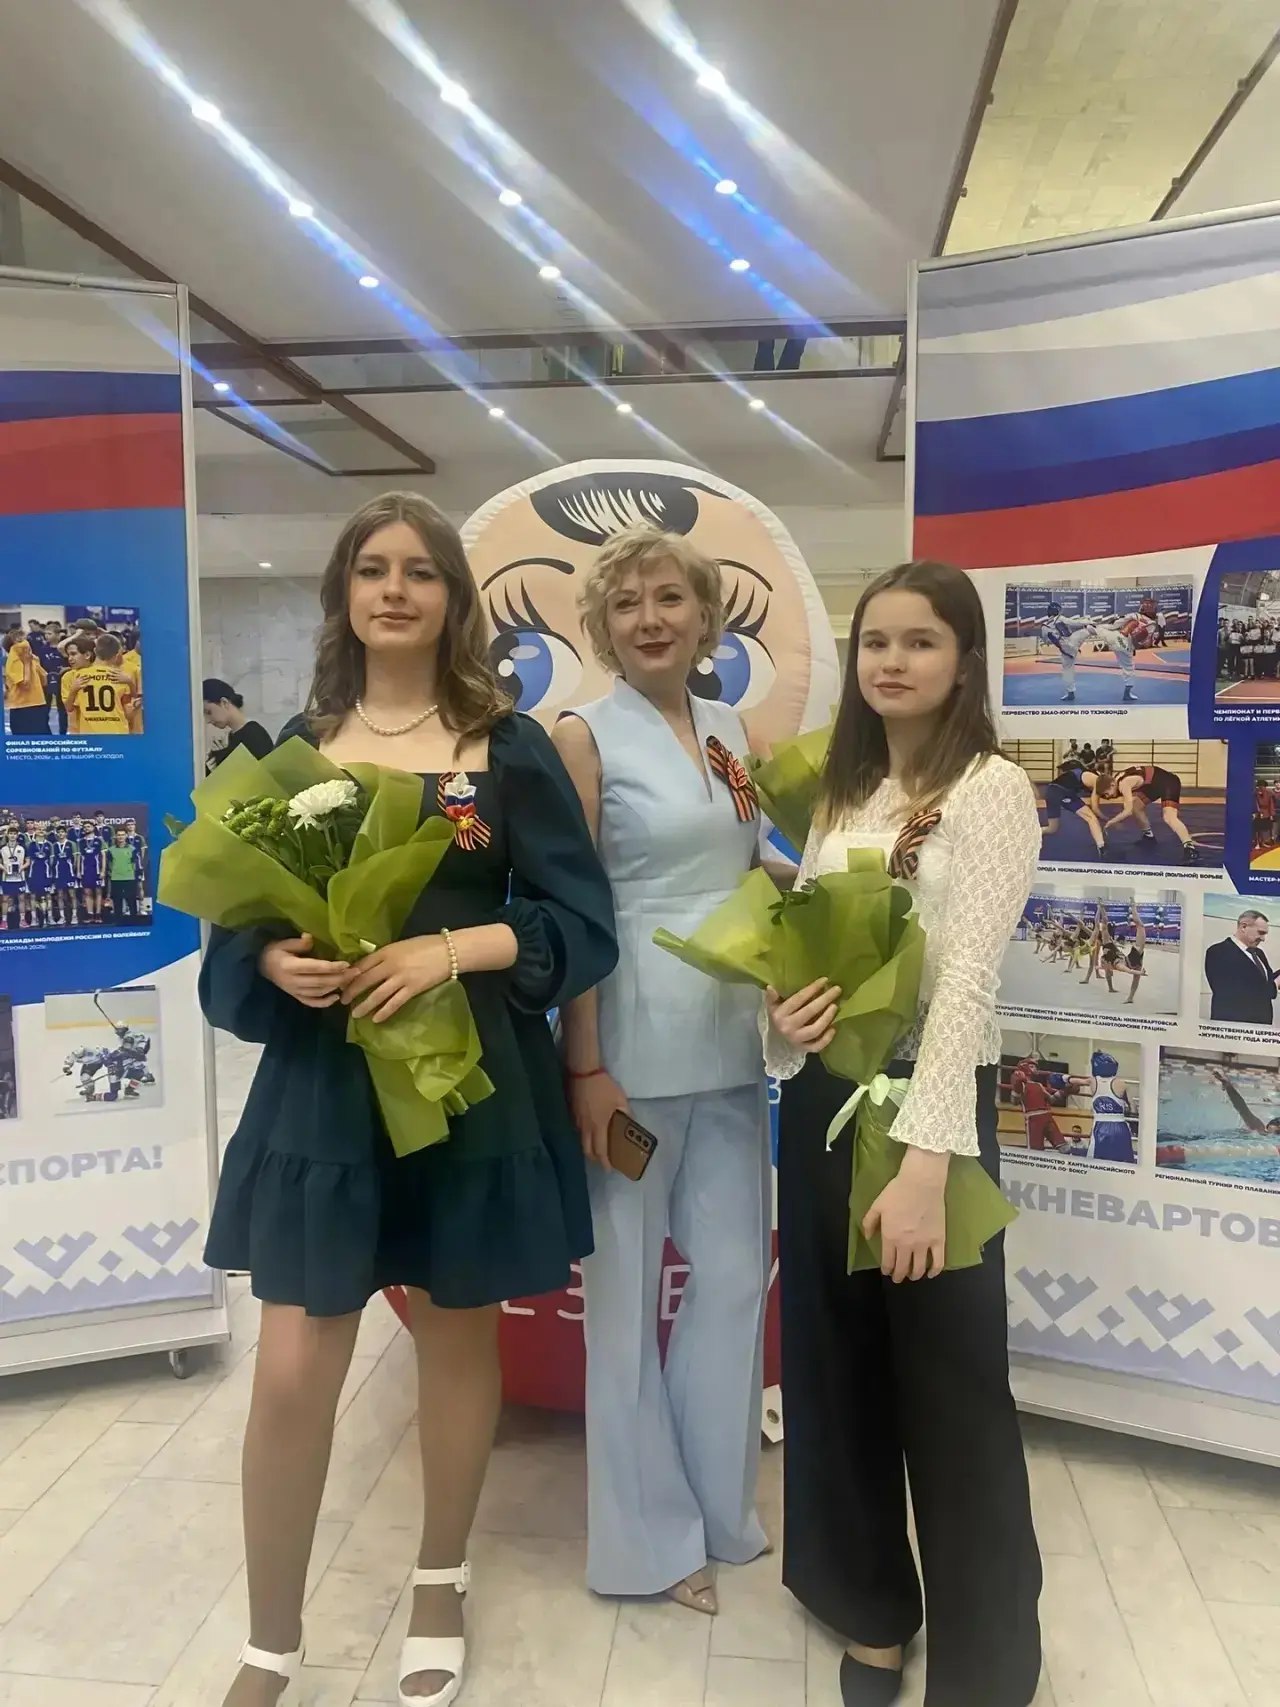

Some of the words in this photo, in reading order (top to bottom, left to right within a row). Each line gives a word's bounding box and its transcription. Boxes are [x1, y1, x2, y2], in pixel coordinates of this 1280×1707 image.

[83, 685, 115, 712] 10
[1003, 1012, 1054, 1021] ХУДОЖЕСТВЕННОЙ
[1054, 1017, 1092, 1025] ГИМНАСТИКЕ
[1024, 1008, 1058, 1016] ПЕРВЕНСТВО
[1064, 1012, 1098, 1020] ЧЕМПИОНАТ
[1124, 1018, 1178, 1027] НИЖНЕВАРТОВСКА
[1198, 1025, 1254, 1034] ТОРЖЕСТВЕННАЯ
[0, 1145, 163, 1186] ПОРТА!
[1029, 1156, 1065, 1166] ПЕРВЕНСТВО
[1068, 1161, 1136, 1175] ХАНТЫ-МАНСИЙСКОГО
[1155, 1174, 1207, 1185] РЕГИОНАЛЬНЫЙ
[1208, 1180, 1232, 1188] ТУРНИР
[1000, 1178, 1280, 1248] ЖНЕВАРТОВ
